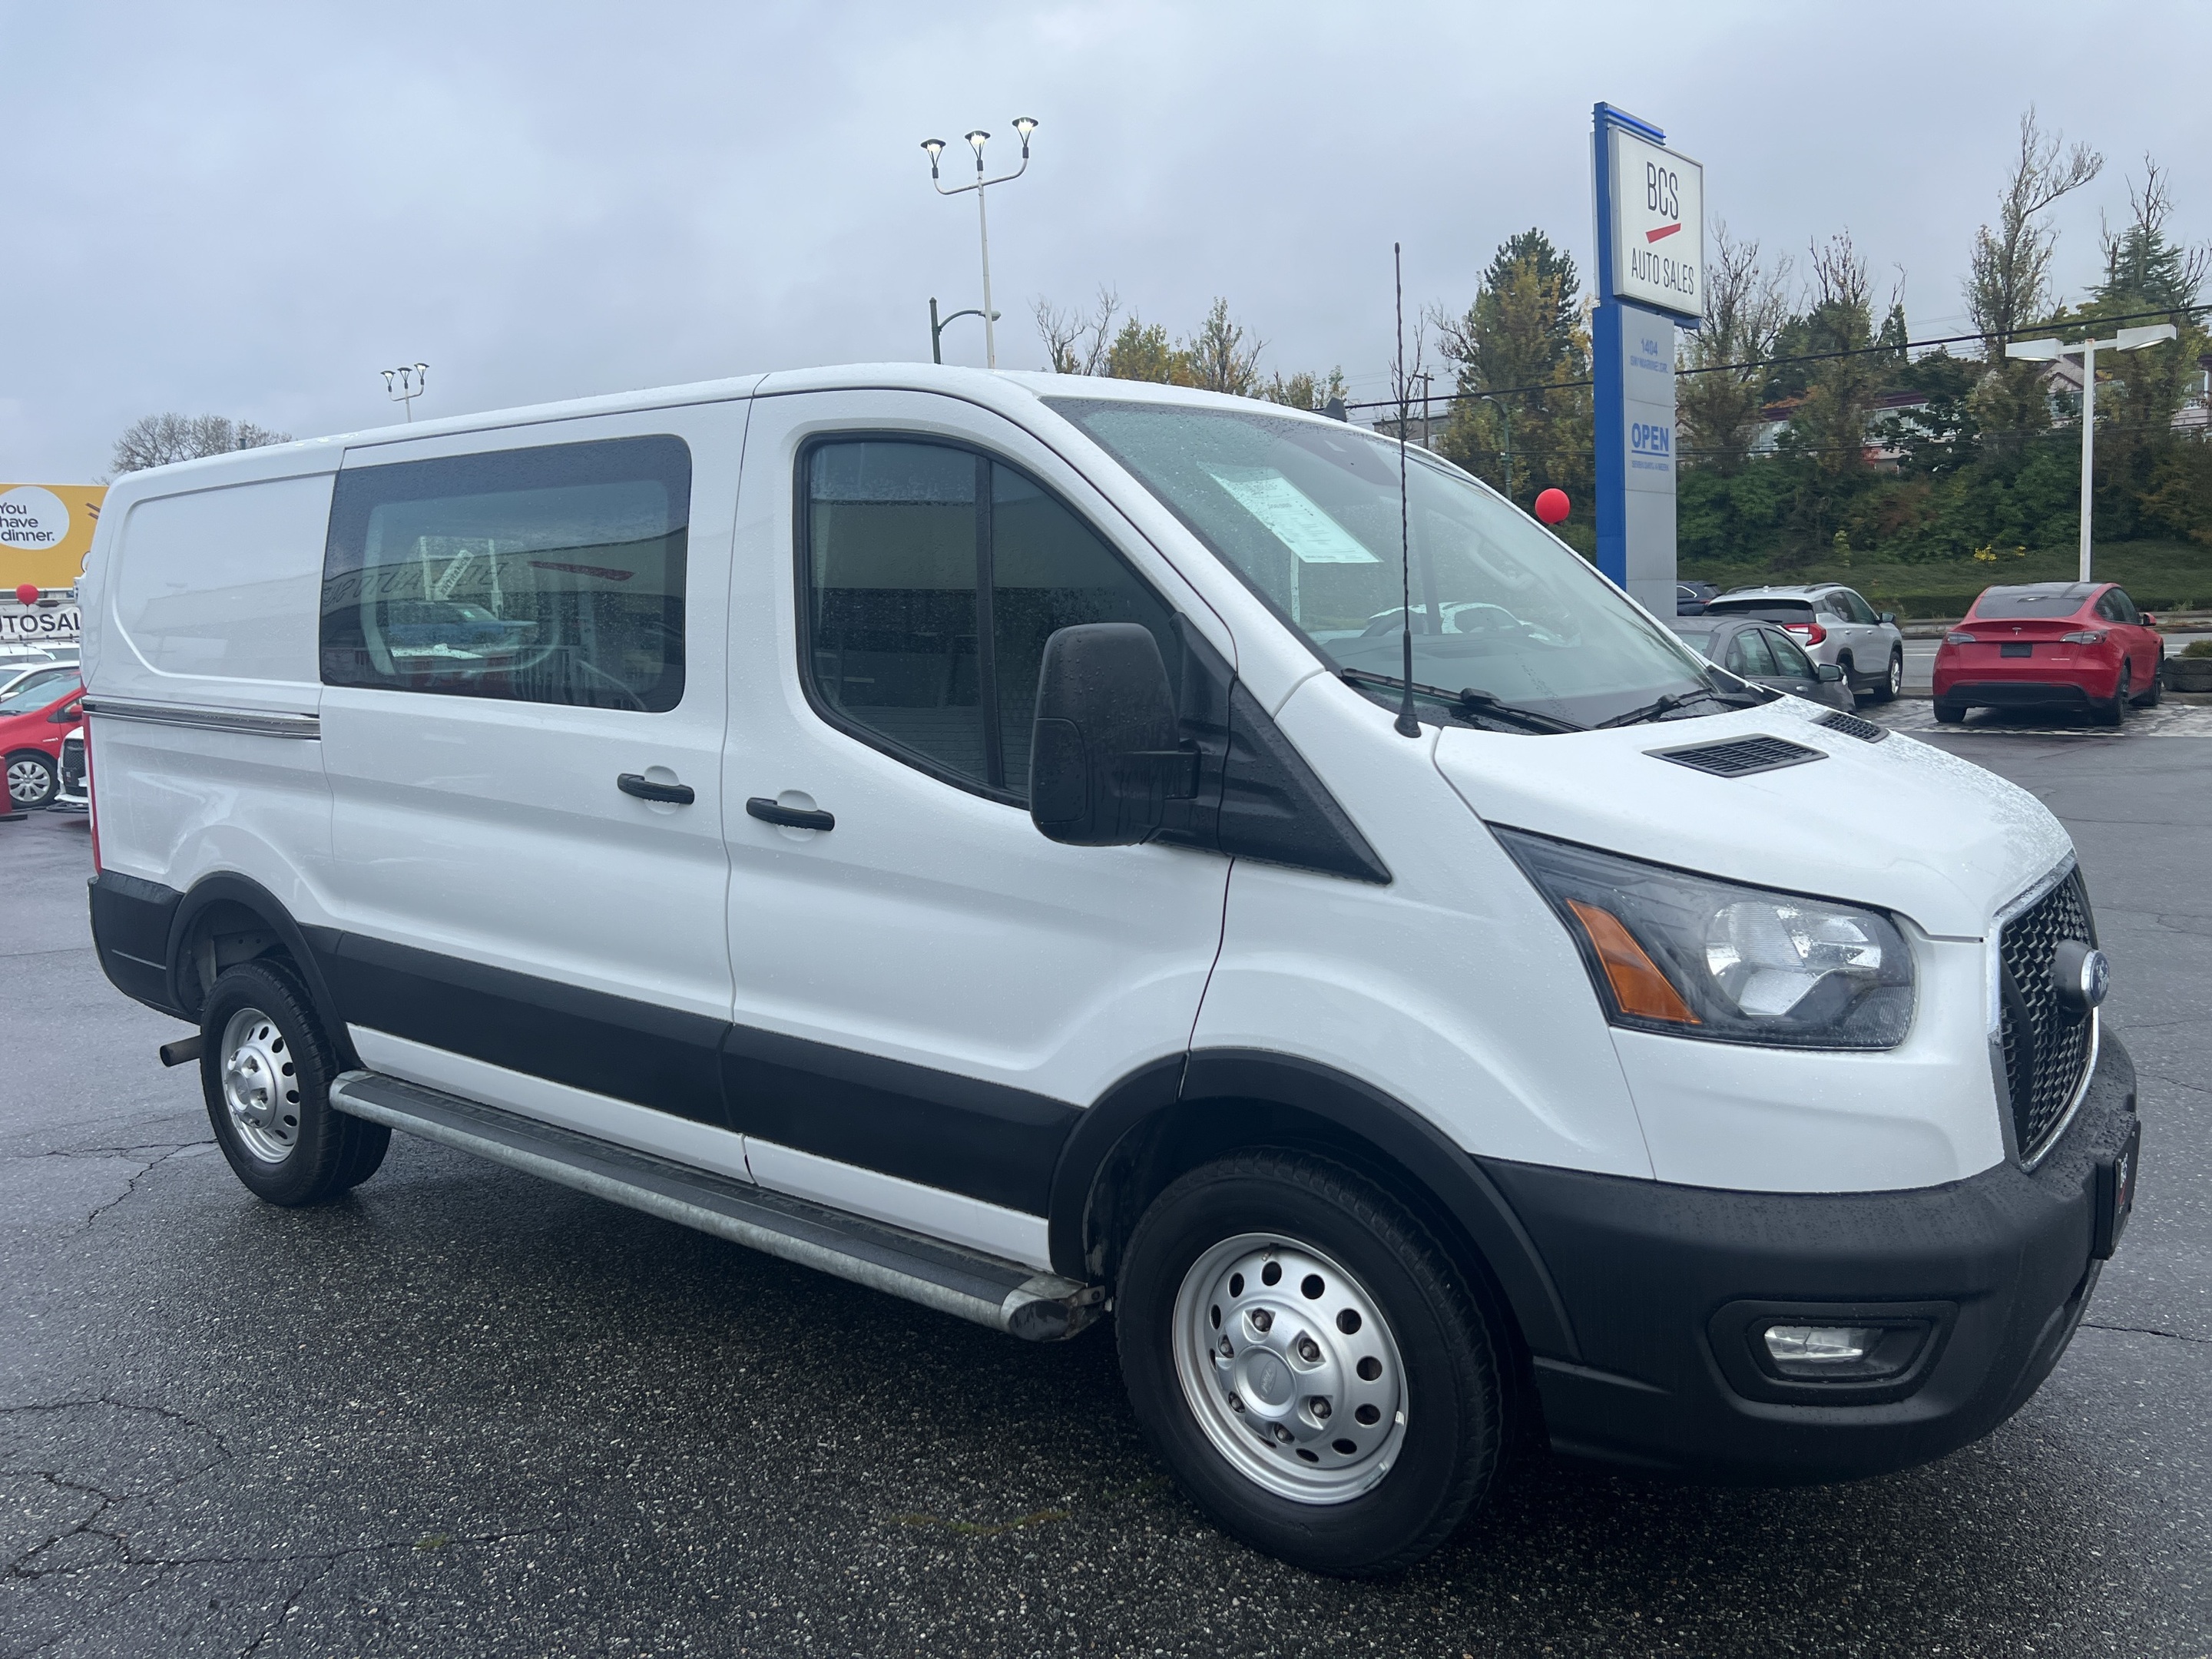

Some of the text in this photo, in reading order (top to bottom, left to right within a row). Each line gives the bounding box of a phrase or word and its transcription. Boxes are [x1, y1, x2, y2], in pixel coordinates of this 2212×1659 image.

[1646, 161, 1679, 220] BCS
[1631, 247, 1694, 296] AUTO SALES
[1641, 338, 1659, 356] 1404
[1631, 422, 1670, 452] OPEN
[0, 502, 28, 515] You
[0, 515, 39, 528] have
[1, 528, 55, 541] dinner.
[0, 612, 80, 633] TOSAL
